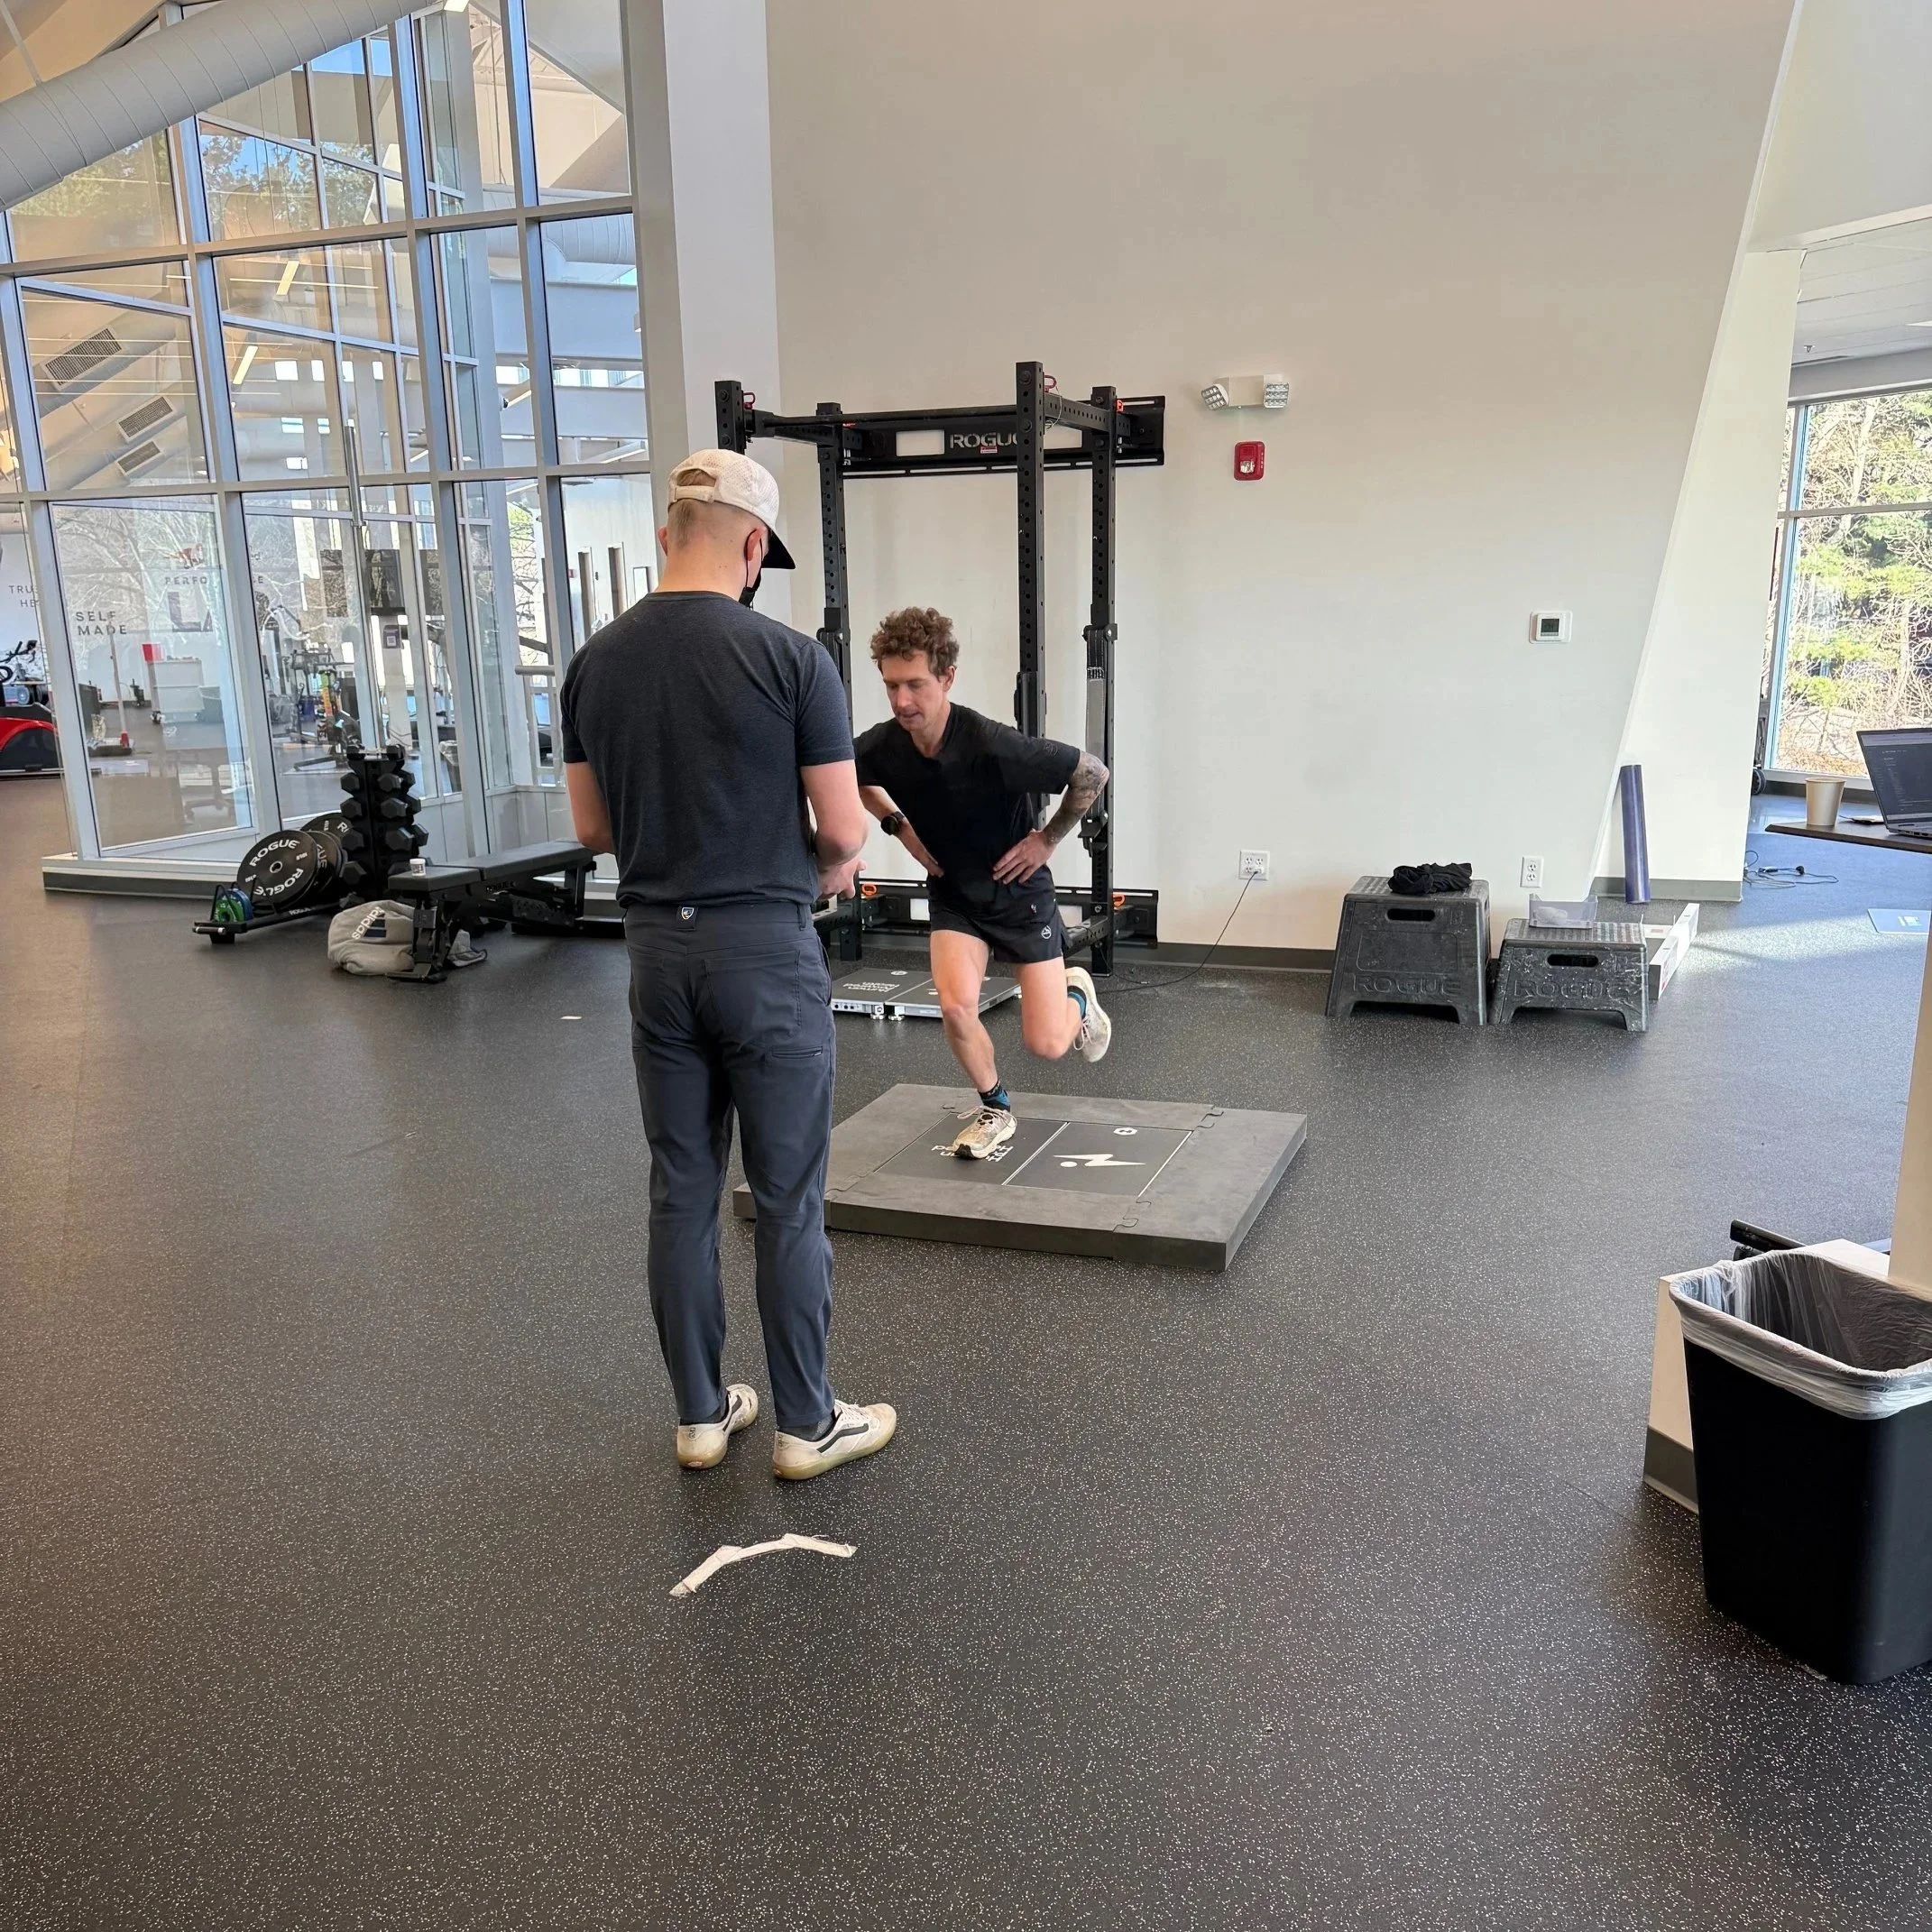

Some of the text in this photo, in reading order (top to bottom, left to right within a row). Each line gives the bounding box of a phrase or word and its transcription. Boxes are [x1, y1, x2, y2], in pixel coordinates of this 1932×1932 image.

[950, 432, 1017, 448] ROGU
[165, 576, 207, 585] PERFO
[76, 611, 116, 621] SELF
[78, 624, 127, 636] MADE
[249, 839, 300, 867] ROGUE
[1353, 974, 1462, 997] ROGUE
[1514, 979, 1631, 1001] ROGUE
